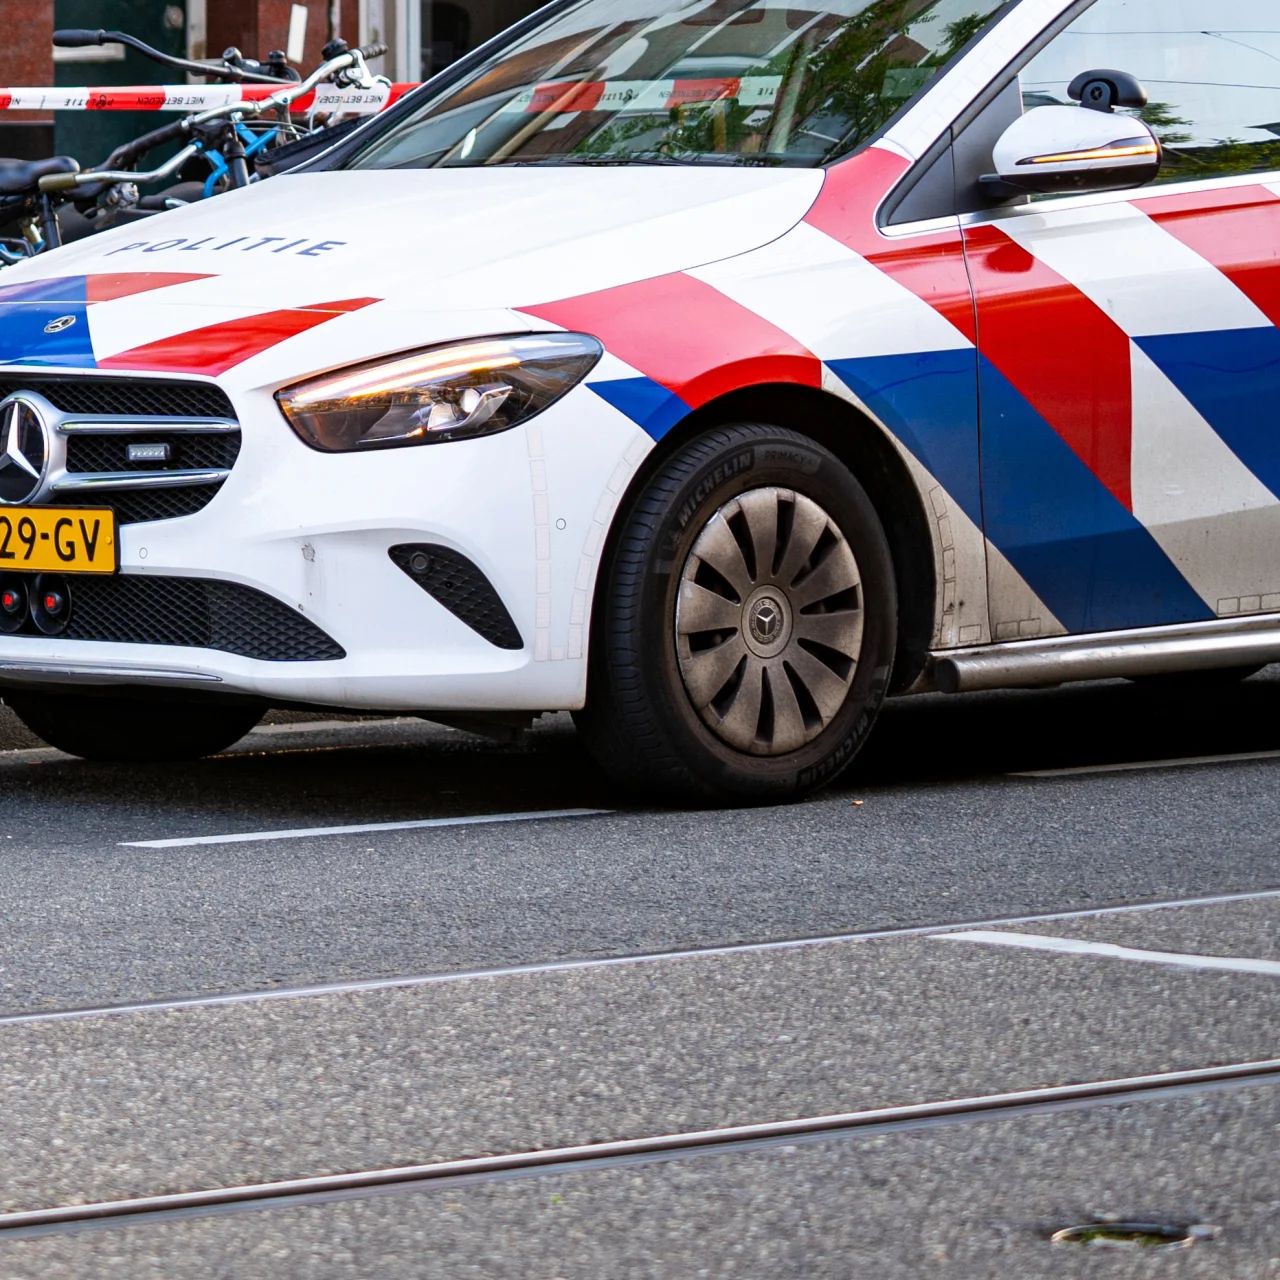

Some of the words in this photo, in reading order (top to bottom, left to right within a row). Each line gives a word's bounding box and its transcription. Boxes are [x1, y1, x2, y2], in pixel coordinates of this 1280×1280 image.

[0, 97, 21, 106] NIET
[136, 96, 182, 105] BETREDEN
[184, 96, 205, 105] NIET
[362, 95, 383, 104] NIET
[103, 236, 348, 257] POLITIE
[764, 450, 807, 464] PRIMACY
[679, 451, 753, 528] MICHELIN
